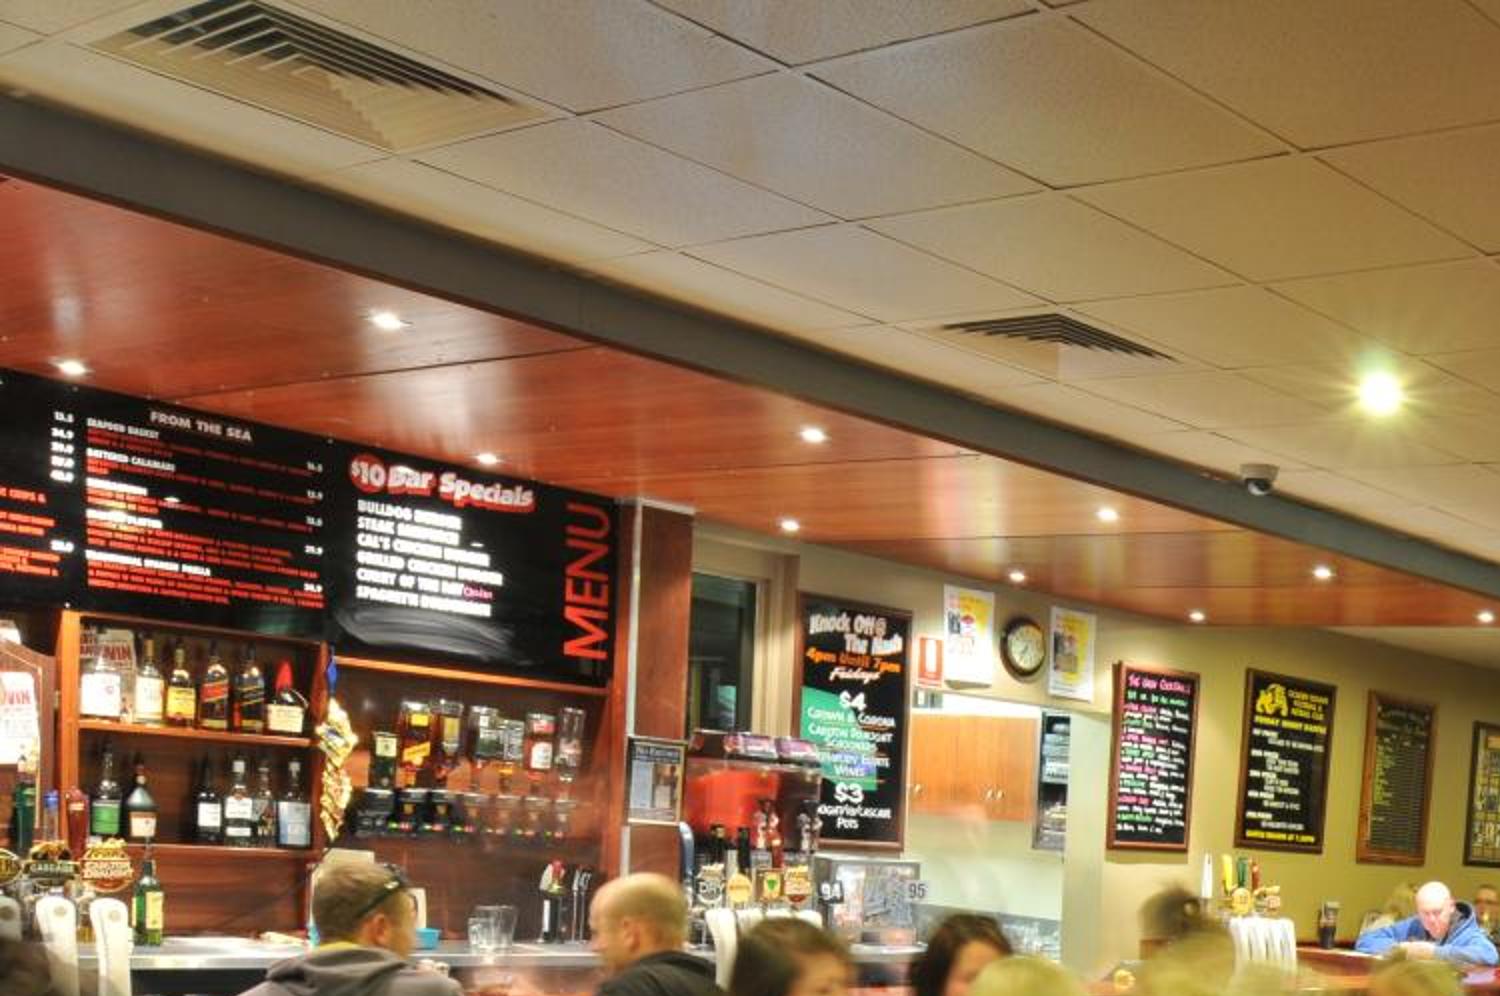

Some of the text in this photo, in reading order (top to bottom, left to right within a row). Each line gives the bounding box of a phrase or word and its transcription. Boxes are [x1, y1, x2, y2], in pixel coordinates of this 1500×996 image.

[150, 411, 252, 442] FROM THE SEA
[352, 461, 533, 506] $10 Bar Specials
[358, 500, 412, 520] BULLDOG
[564, 502, 609, 660] MENU
[810, 612, 850, 634] Knock
[840, 690, 866, 710] $4
[834, 782, 864, 804] $3
[820, 882, 843, 901] 94
[908, 882, 926, 900] 95
